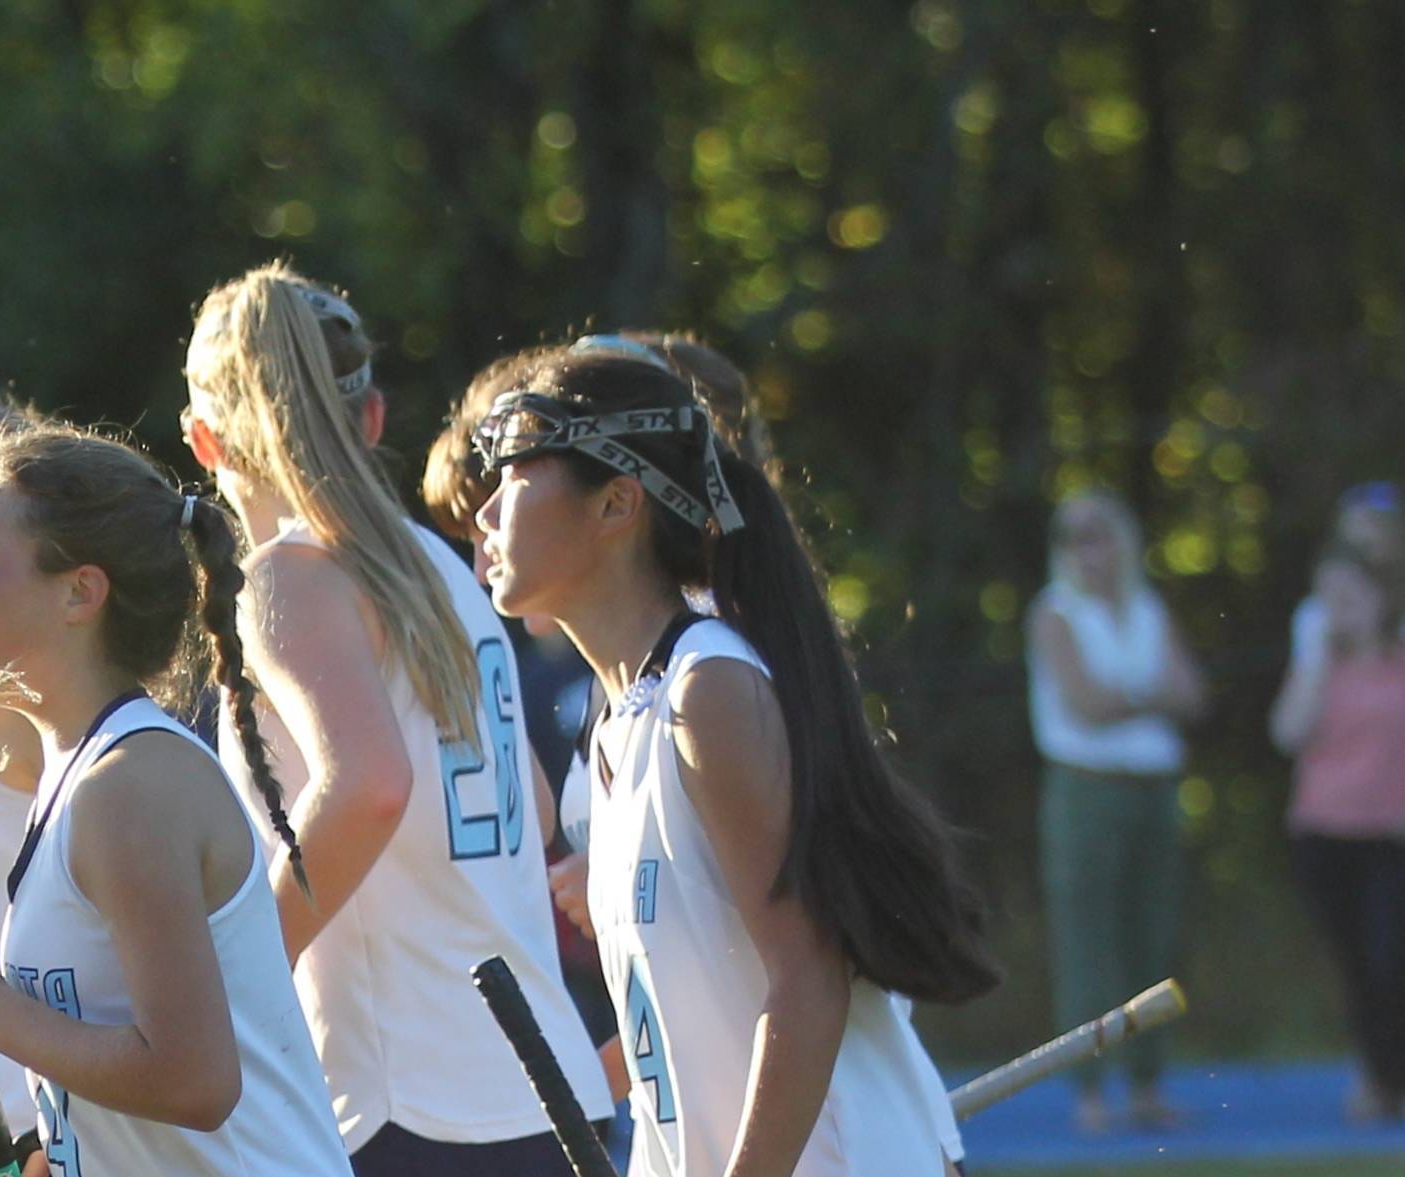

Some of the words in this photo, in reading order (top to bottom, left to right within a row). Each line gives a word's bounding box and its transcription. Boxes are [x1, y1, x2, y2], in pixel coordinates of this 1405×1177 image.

[566, 418, 601, 441] TX
[628, 412, 672, 430] STX
[599, 442, 649, 478] STX
[660, 484, 698, 519] STX
